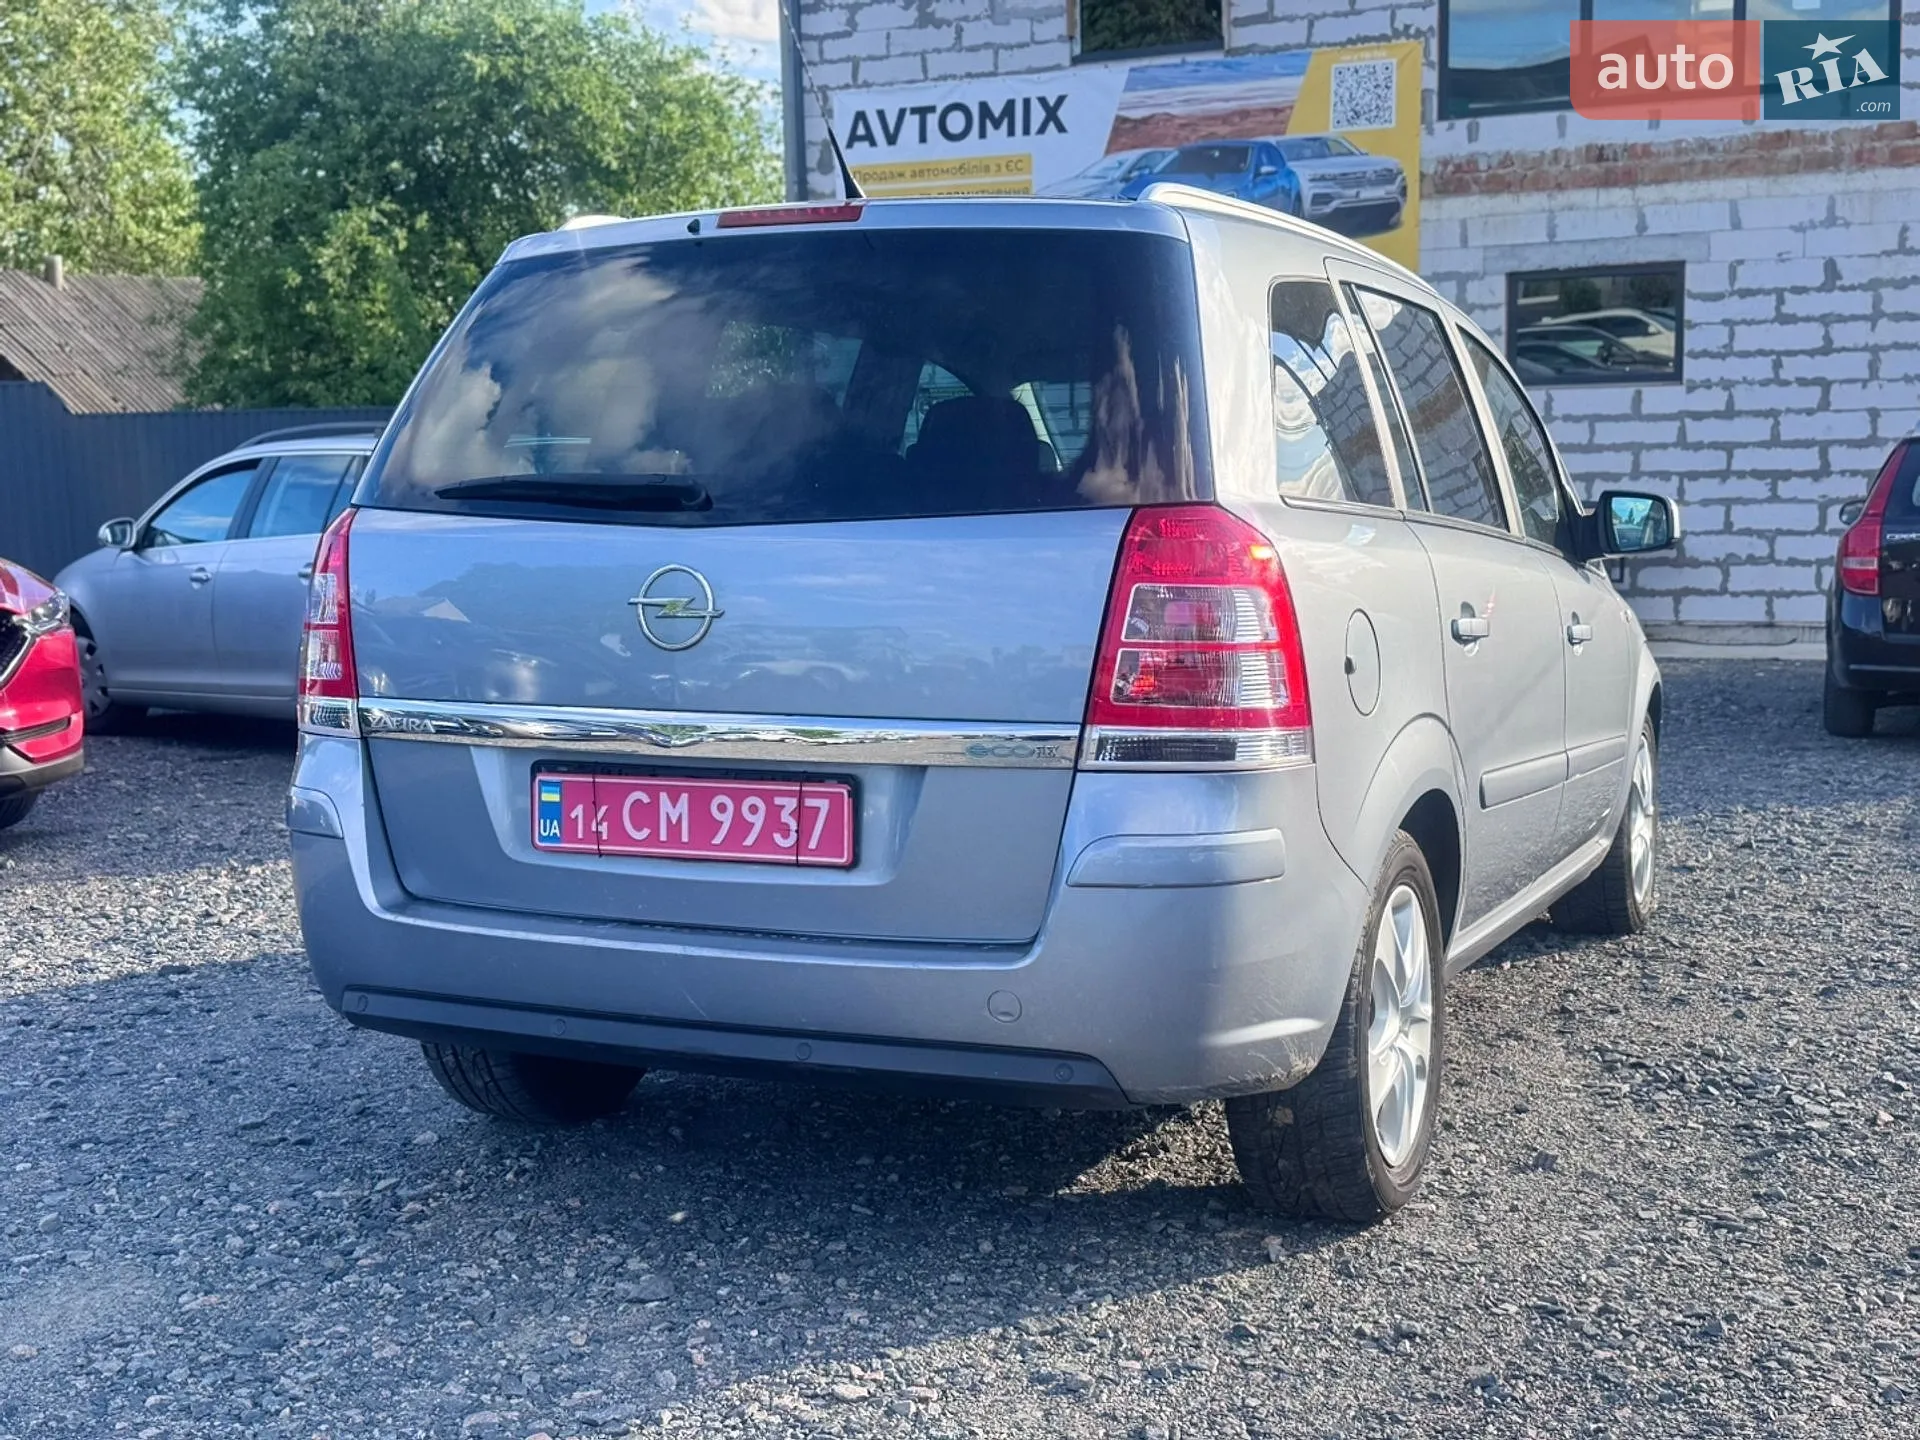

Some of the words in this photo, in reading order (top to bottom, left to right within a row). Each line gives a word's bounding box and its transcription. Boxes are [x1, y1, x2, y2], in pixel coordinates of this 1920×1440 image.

[845, 93, 1069, 150] AVTOMIX
[853, 169, 907, 184] Продаж
[910, 162, 991, 179] автомобілів
[1005, 160, 1024, 171] ЄС
[368, 714, 436, 733] ZAFIRA
[540, 819, 560, 837] UA
[569, 804, 608, 840] 14
[622, 790, 690, 843] CM
[709, 794, 831, 850] 9937
